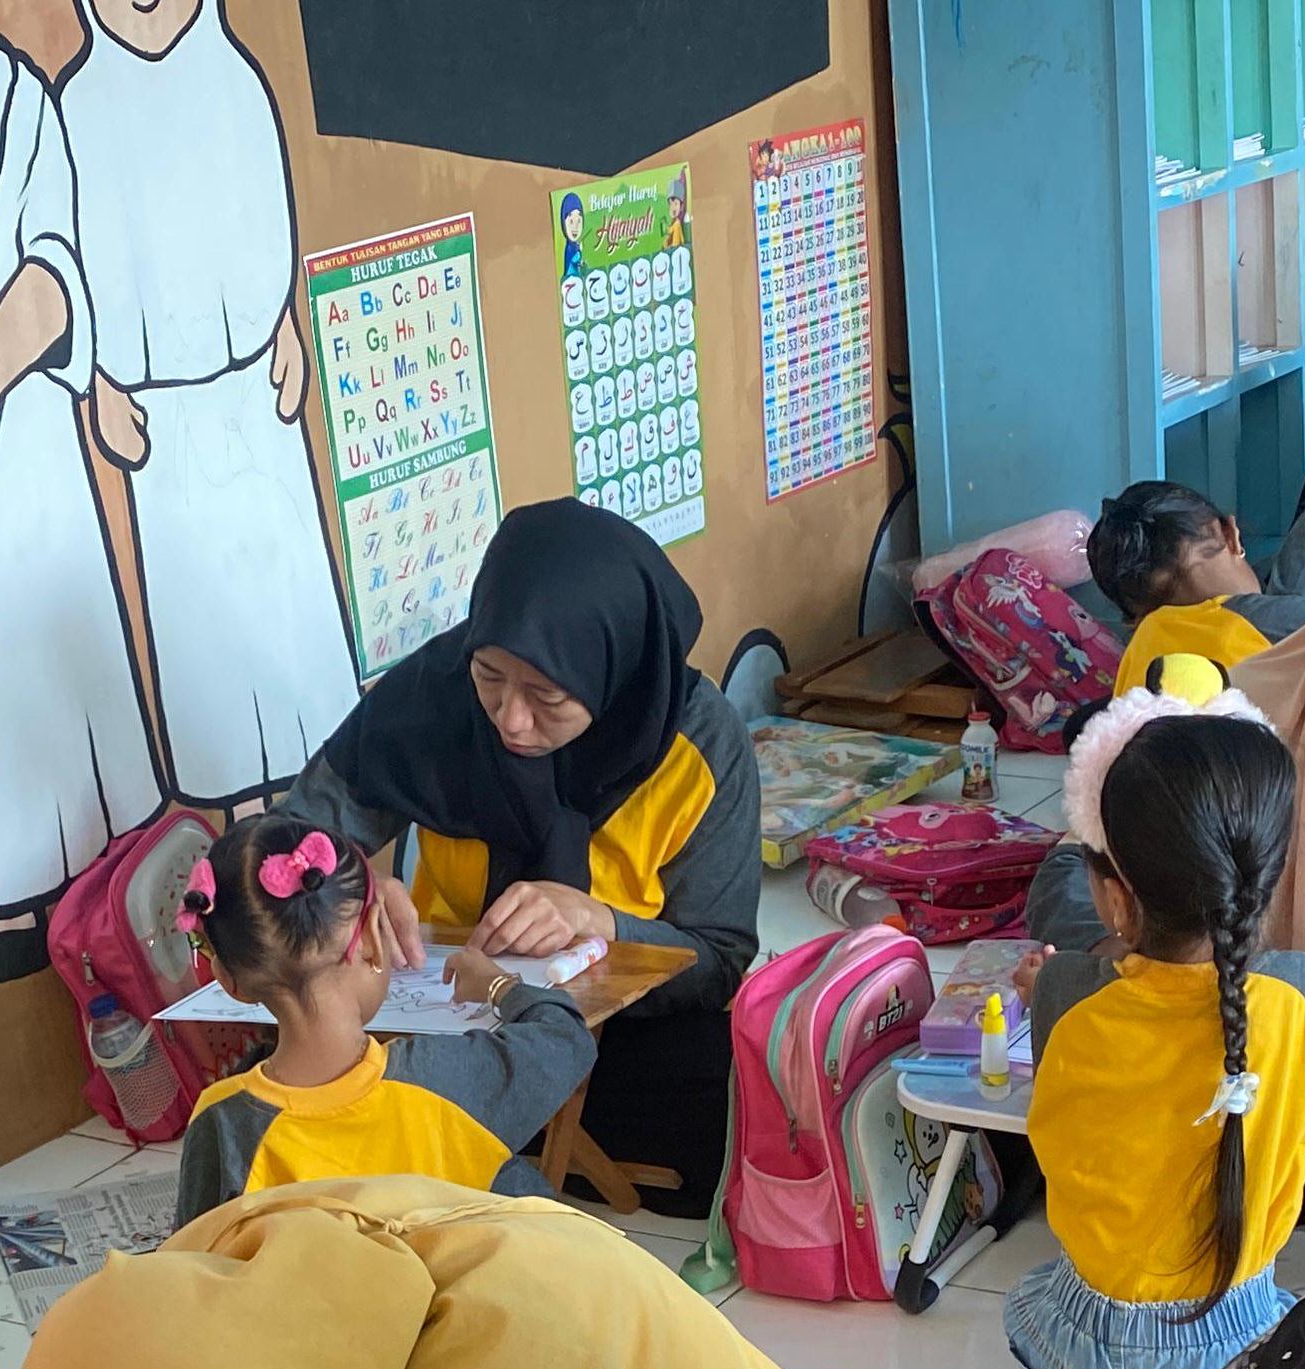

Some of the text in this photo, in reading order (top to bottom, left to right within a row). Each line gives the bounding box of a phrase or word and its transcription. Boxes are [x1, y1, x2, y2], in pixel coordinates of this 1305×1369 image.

[759, 185, 764, 198] 1
[772, 182, 776, 194] 2
[783, 180, 788, 192] 3
[794, 177, 799, 188] 4
[805, 174, 810, 186] 5
[816, 171, 821, 183] 6
[826, 168, 832, 180] 7
[837, 165, 842, 178] 8
[847, 162, 852, 176] 9
[759, 195, 854, 230] 11 12 13 14 15 16 17 19
[314, 256, 348, 272] BENTUK
[388, 235, 419, 251] TANGAN
[421, 229, 442, 244] YANG
[443, 223, 466, 237] BARU
[351, 246, 438, 283] HURUF TEGAK
[761, 244, 793, 263] 21 22 23
[328, 267, 461, 326] Aa Bb Cc Dd Ee
[762, 280, 783, 295] 31 32
[334, 302, 462, 362] Ff Gg Hh Ii Jj
[764, 313, 773, 326] 41
[339, 337, 468, 398] Kk Ll Mm Nn Oo
[765, 342, 786, 359] 51 52
[766, 377, 774, 390] 61
[344, 371, 470, 433] Pp Qq Rr Ss Tt
[767, 407, 775, 421] 71
[348, 403, 476, 469] Uu Vv Ww Xx Yy Zz
[369, 440, 467, 489] HURUF SAMBUNG
[770, 470, 778, 483] 91
